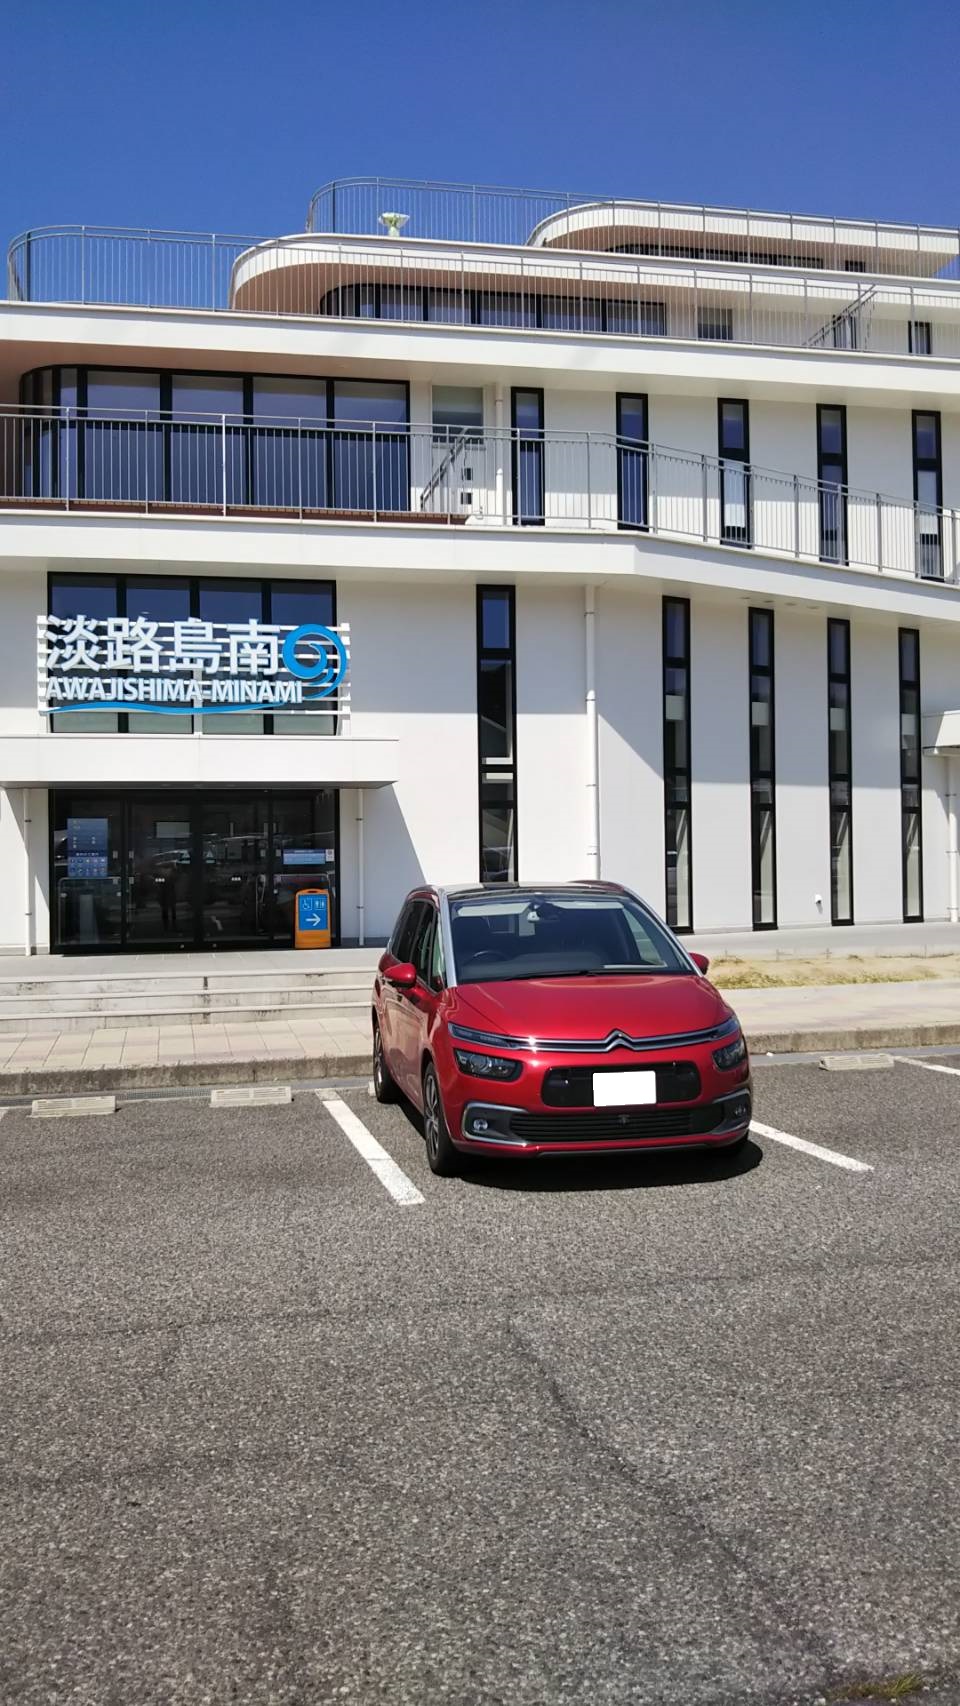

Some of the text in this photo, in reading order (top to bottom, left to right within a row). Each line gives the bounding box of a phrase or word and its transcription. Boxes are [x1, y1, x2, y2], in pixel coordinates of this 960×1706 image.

[45, 614, 280, 675] 淡路島南
[45, 676, 303, 703] AWAJISHIMA-MINAMI
